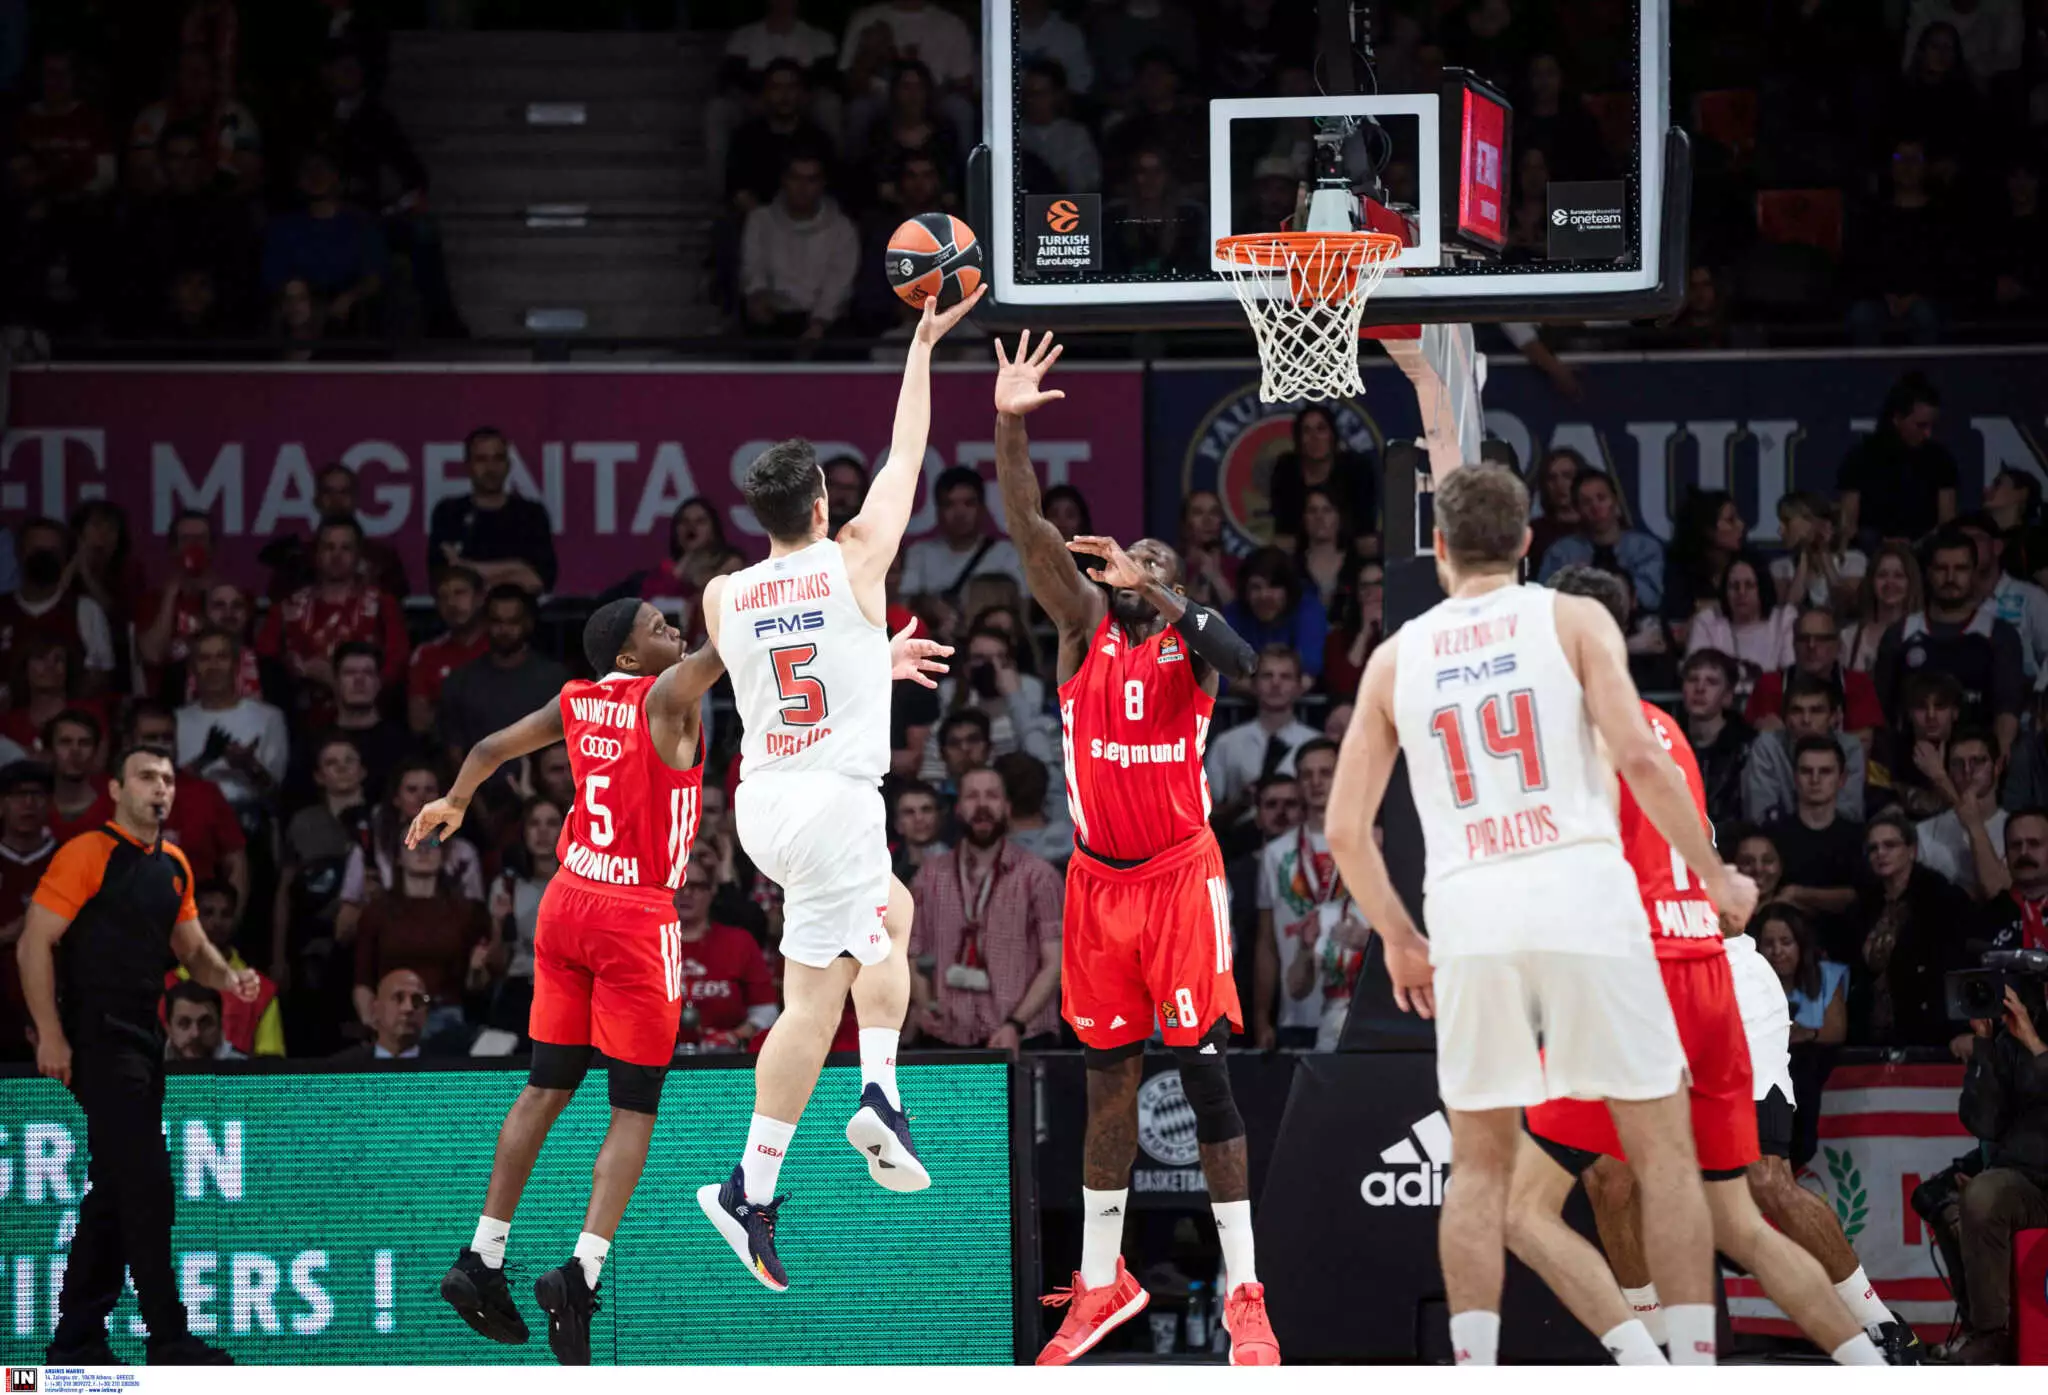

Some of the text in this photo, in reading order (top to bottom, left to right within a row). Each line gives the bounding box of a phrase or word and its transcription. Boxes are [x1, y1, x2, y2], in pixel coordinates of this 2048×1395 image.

[1570, 213, 1621, 224] oneteam
[1037, 235, 1089, 246] TURKISH
[1037, 246, 1090, 256] AIRLINES
[1036, 257, 1091, 267] EuroLeague
[735, 571, 831, 613] LARENTZAKIS
[754, 610, 825, 639] FMS
[769, 642, 829, 727] 5
[1436, 654, 1517, 690] FMS
[569, 697, 637, 730] WINSTON
[1124, 680, 1144, 721] 8
[1090, 736, 1186, 768] siegmund
[1430, 687, 1548, 809] 14
[585, 774, 615, 848] 5
[1465, 804, 1560, 860] PIRAEUS
[564, 842, 640, 885] MUNICH
[1175, 988, 1198, 1028] 8
[1361, 1161, 1452, 1206] adi
